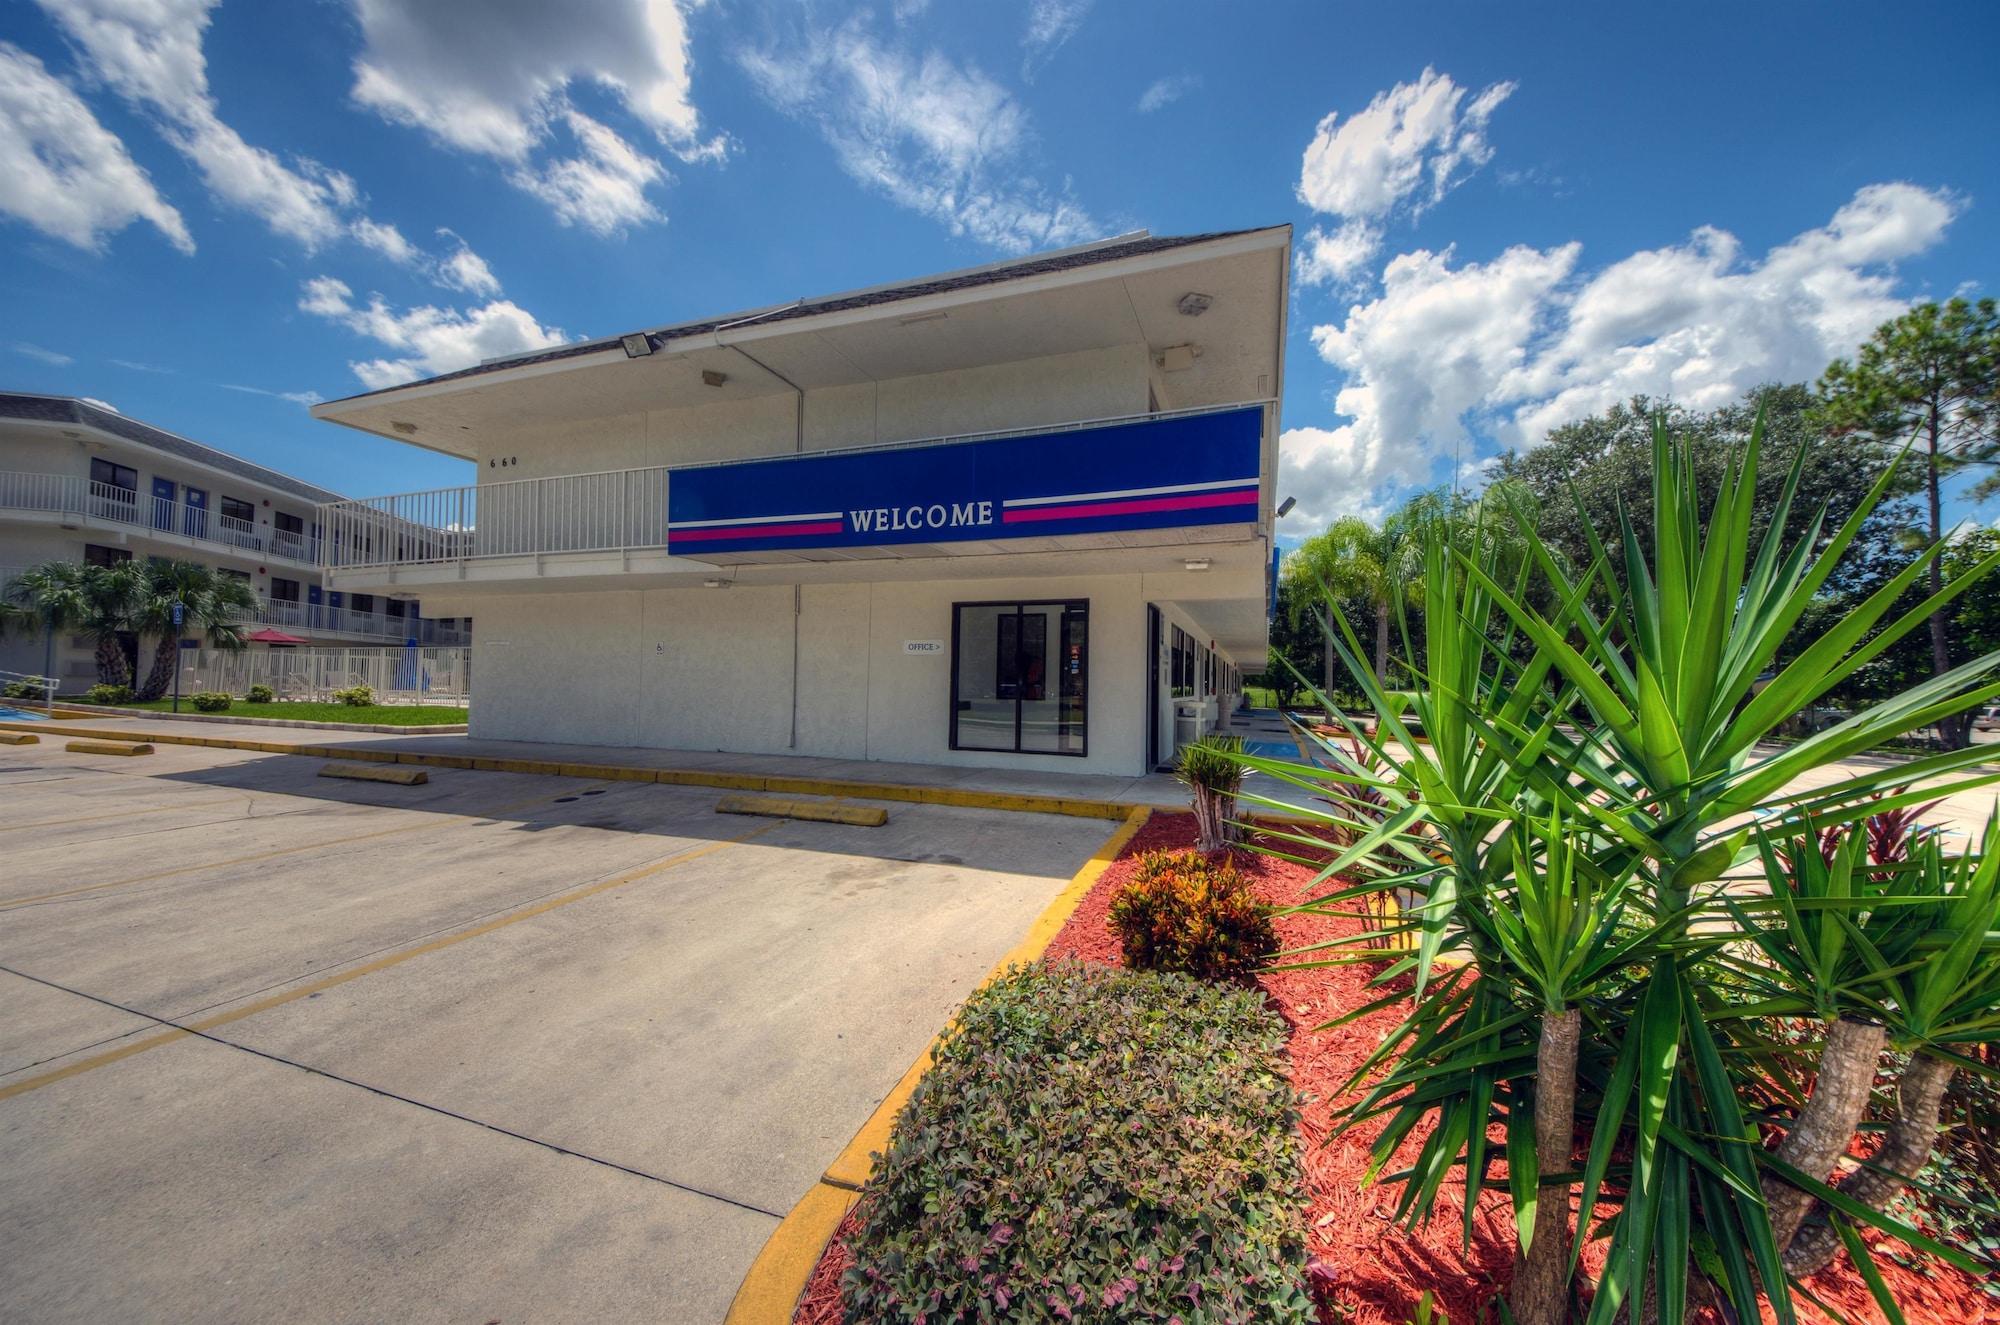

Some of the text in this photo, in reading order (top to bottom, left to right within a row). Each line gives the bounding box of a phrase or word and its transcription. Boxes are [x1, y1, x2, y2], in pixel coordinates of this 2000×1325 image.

[490, 456, 517, 468] 660
[849, 501, 993, 532] WELCOME
[908, 643, 934, 651] OFFICE
